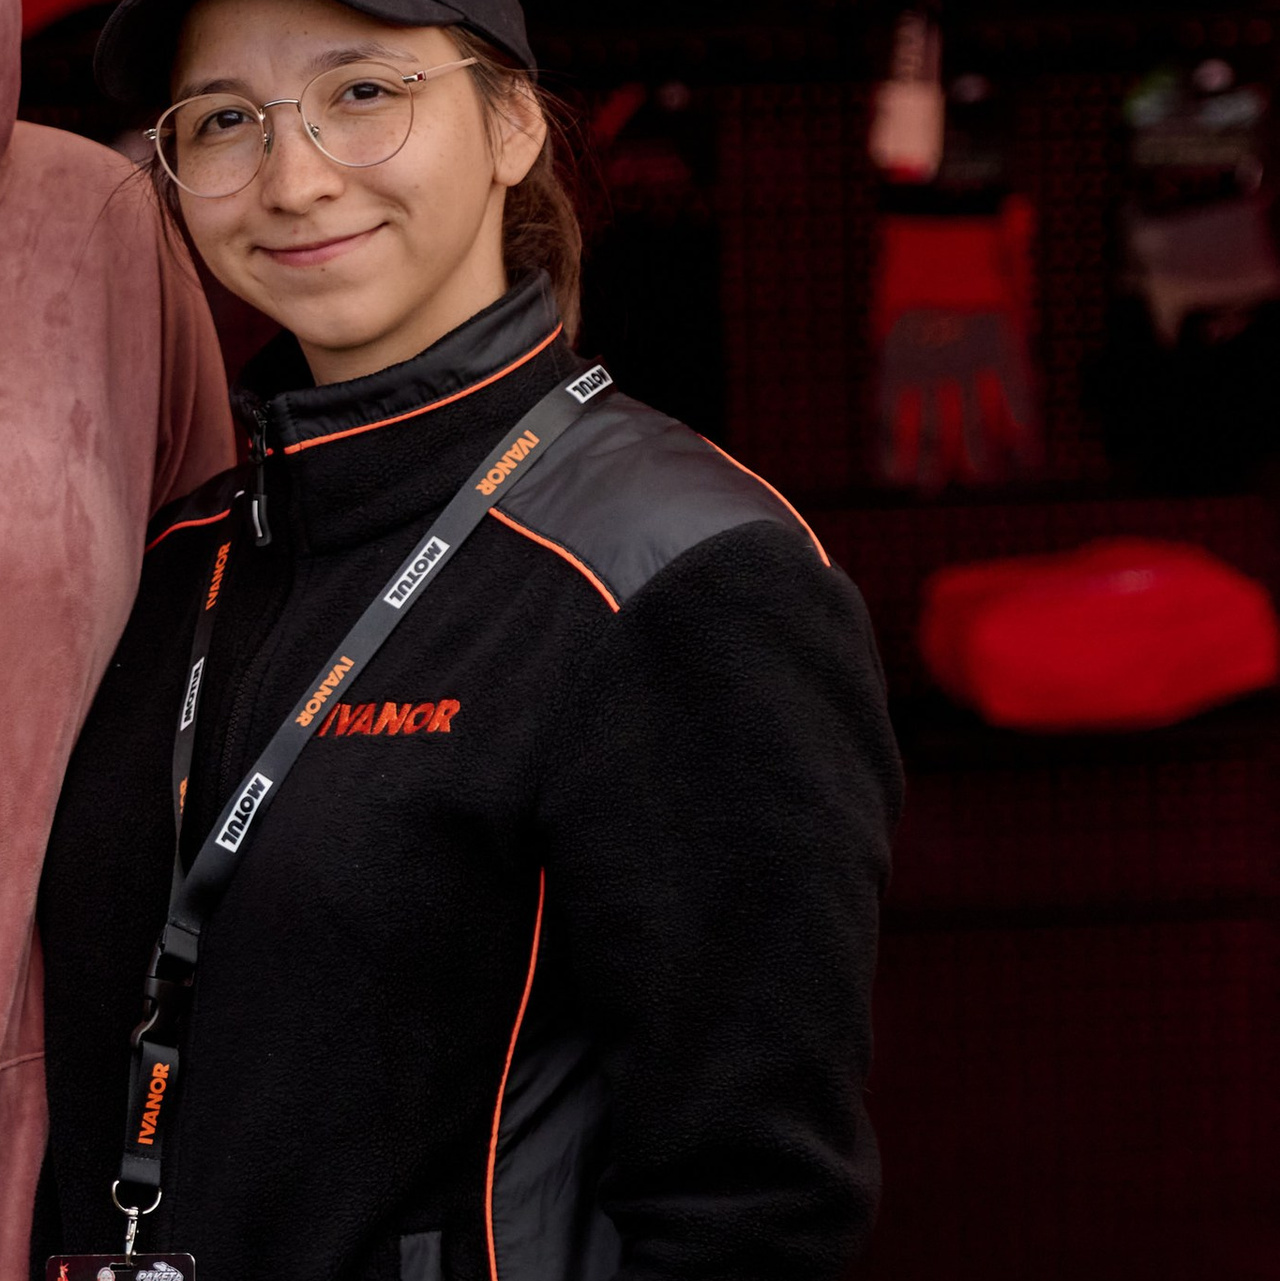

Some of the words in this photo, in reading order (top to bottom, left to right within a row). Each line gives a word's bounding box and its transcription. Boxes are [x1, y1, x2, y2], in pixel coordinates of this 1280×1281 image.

[475, 429, 540, 496] IVANOR
[205, 541, 232, 611] IVANOR
[389, 540, 443, 603] MOTUL
[295, 655, 355, 727] IVANOR
[318, 698, 461, 737] IVANOR
[220, 777, 266, 846] MOTUL
[138, 1061, 170, 1146] IVANOR
